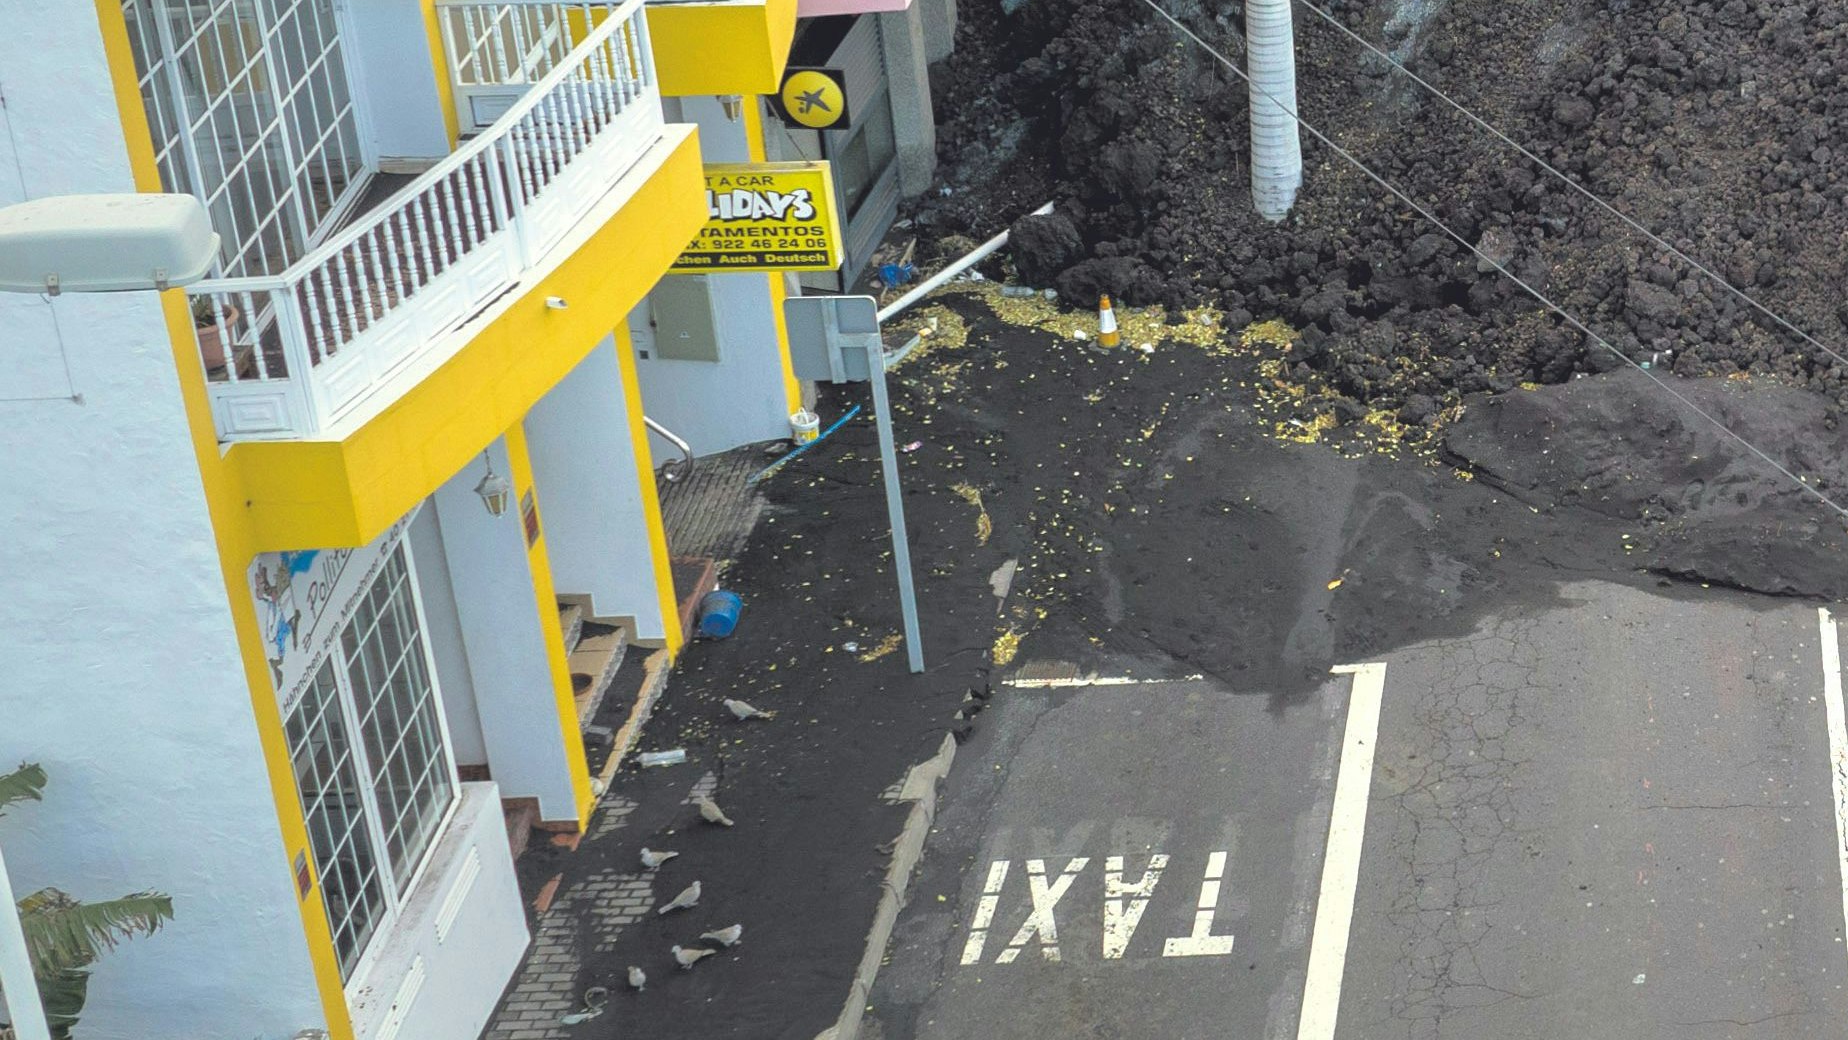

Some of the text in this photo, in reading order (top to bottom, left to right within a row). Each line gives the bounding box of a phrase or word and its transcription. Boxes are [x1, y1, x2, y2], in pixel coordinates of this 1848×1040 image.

[719, 176, 732, 187] A
[735, 175, 775, 187] CAR
[704, 188, 816, 223] LIDAYS
[700, 225, 824, 238] TAMENTOS
[712, 239, 744, 250] 922
[751, 238, 771, 249] 46
[779, 238, 799, 248] 24
[806, 237, 826, 248] 06
[676, 252, 825, 265] chen Auch Deutsch
[960, 851, 1235, 965] TAXI
